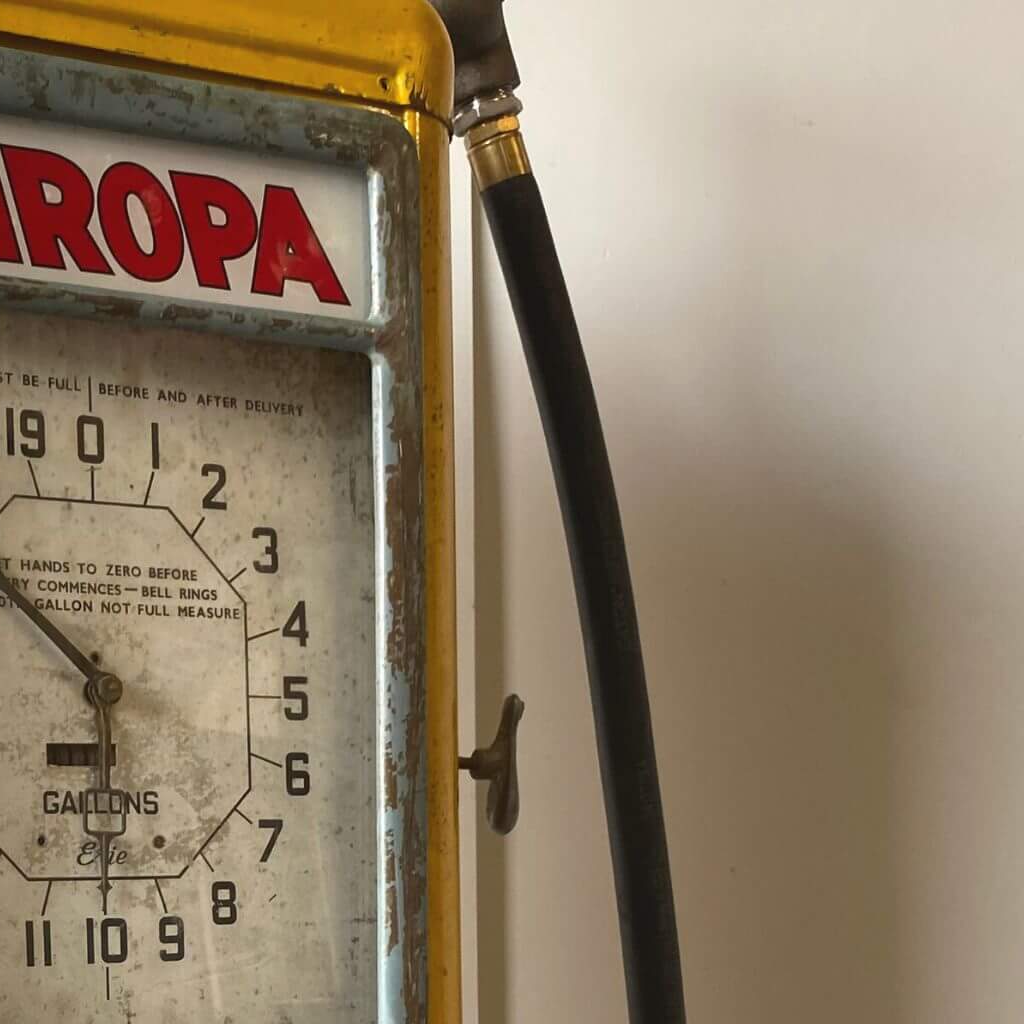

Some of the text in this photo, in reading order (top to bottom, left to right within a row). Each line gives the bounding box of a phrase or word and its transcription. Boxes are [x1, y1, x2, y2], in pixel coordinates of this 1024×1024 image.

[22, 374, 39, 387] BE
[49, 377, 81, 391] FULL
[98, 382, 149, 400] BEFORE
[157, 389, 187, 403] AND
[196, 394, 237, 409] AFTER
[245, 400, 304, 417] DELIVERY
[5, 407, 45, 458] 19
[77, 415, 104, 464] 0
[151, 422, 159, 469] 1
[201, 464, 227, 510] 2
[21, 560, 70, 574] HANDS
[77, 562, 97, 575] TO
[106, 564, 141, 577] ZERO
[149, 567, 198, 581] BEFORE
[252, 526, 279, 573] 3
[34, 598, 92, 612] GALLON
[101, 601, 131, 614] NOT
[137, 603, 170, 617] FULL
[177, 606, 241, 620] MEASURE
[37, 580, 122, 596] COMMENCES
[142, 586, 173, 599] BELL
[180, 588, 218, 601] RINGS
[282, 601, 309, 647] 4
[283, 676, 309, 721] 5
[285, 752, 310, 796] 6
[43, 790, 159, 815] GALLONS
[258, 819, 283, 863] 7
[212, 881, 237, 925] 8
[25, 919, 52, 967] 11
[87, 917, 128, 964] 10
[158, 916, 185, 962] 9
